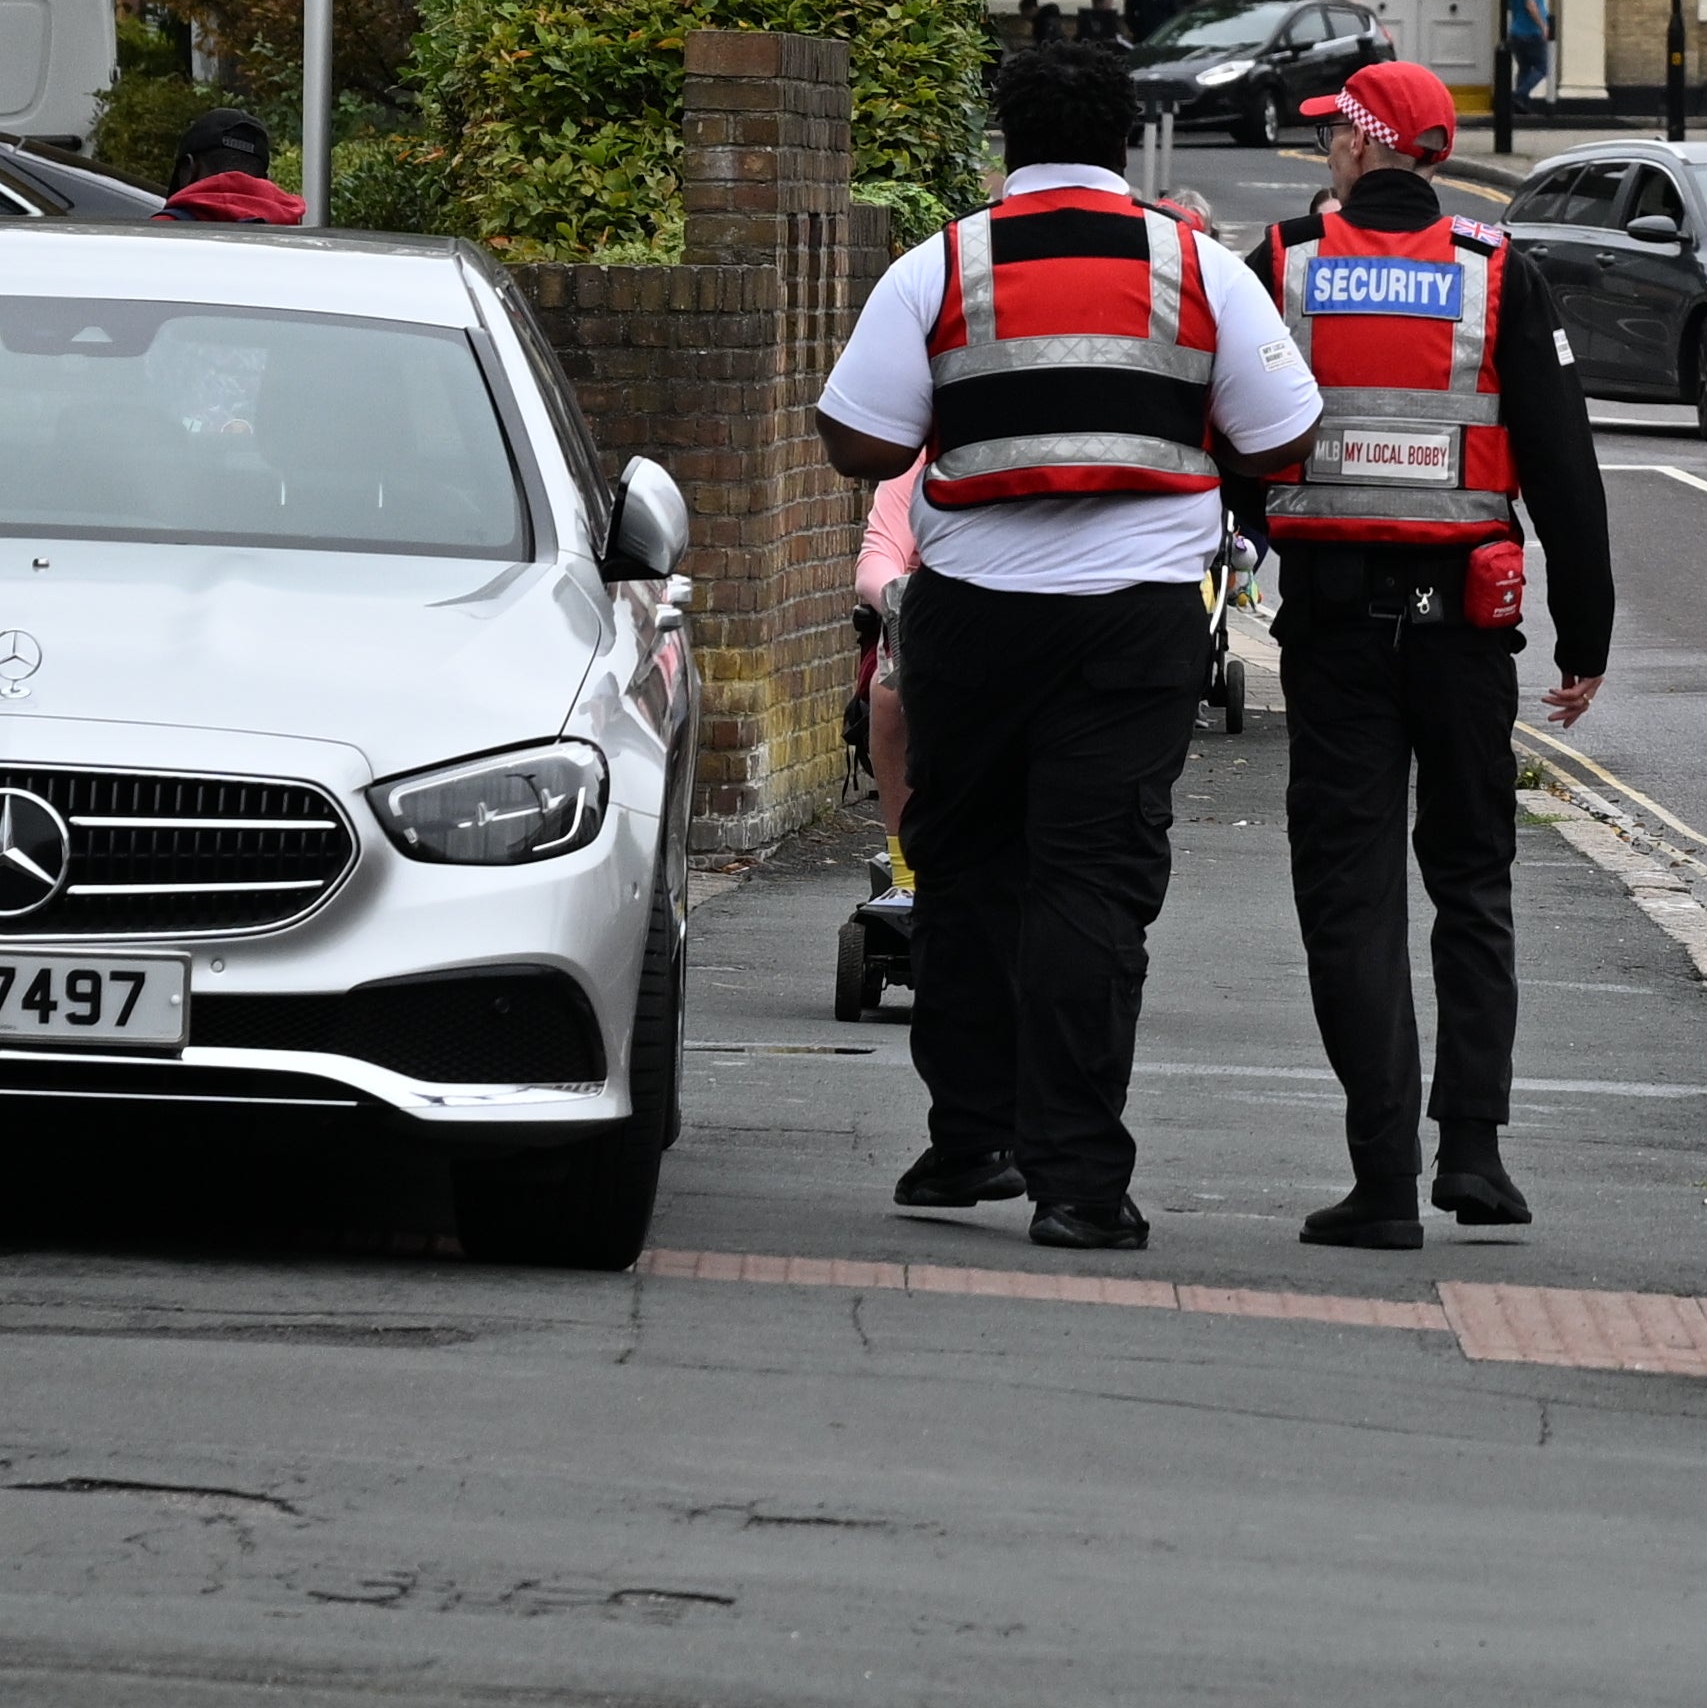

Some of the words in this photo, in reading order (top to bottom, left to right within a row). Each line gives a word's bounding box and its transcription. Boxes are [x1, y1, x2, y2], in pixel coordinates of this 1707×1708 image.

[1314, 267, 1453, 306] SECURITY
[1315, 440, 1340, 461] MLB
[1344, 442, 1363, 462] MY
[1366, 443, 1404, 464] LOCAL
[1408, 445, 1448, 467] BOBBY
